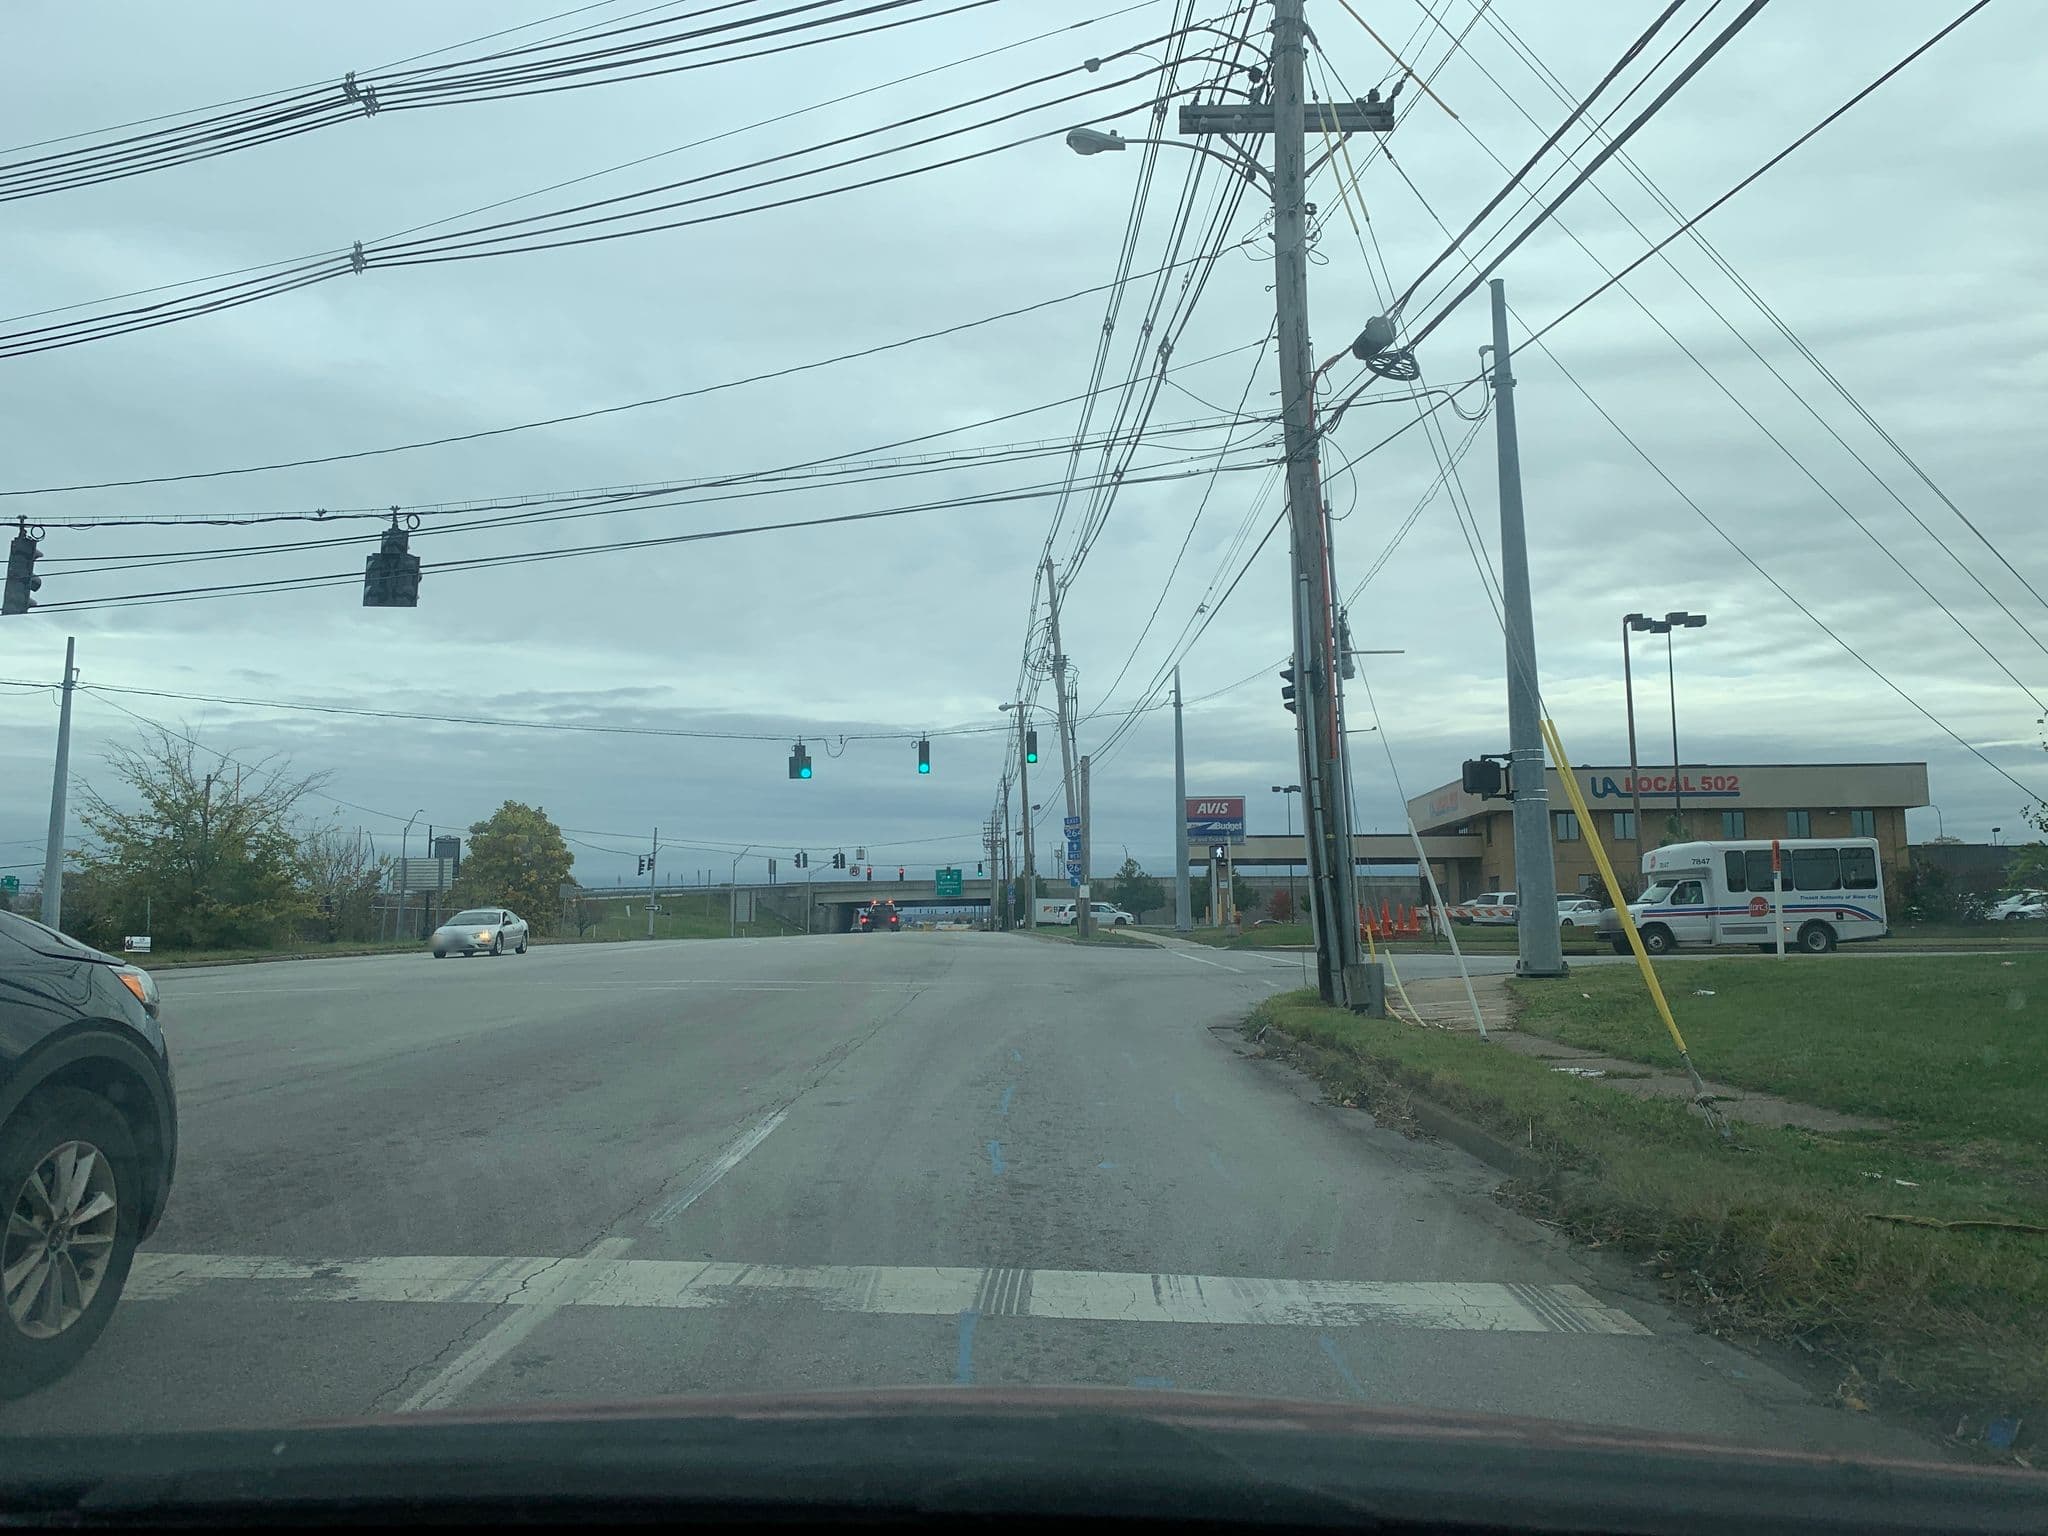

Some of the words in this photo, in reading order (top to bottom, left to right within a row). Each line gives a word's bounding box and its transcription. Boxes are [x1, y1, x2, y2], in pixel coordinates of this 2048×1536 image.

[1591, 776, 1619, 798] UA
[1624, 776, 1696, 792] LOCAL
[1701, 776, 1740, 792] 502
[1197, 803, 1228, 814] AVIS
[1215, 822, 1242, 831] Budget
